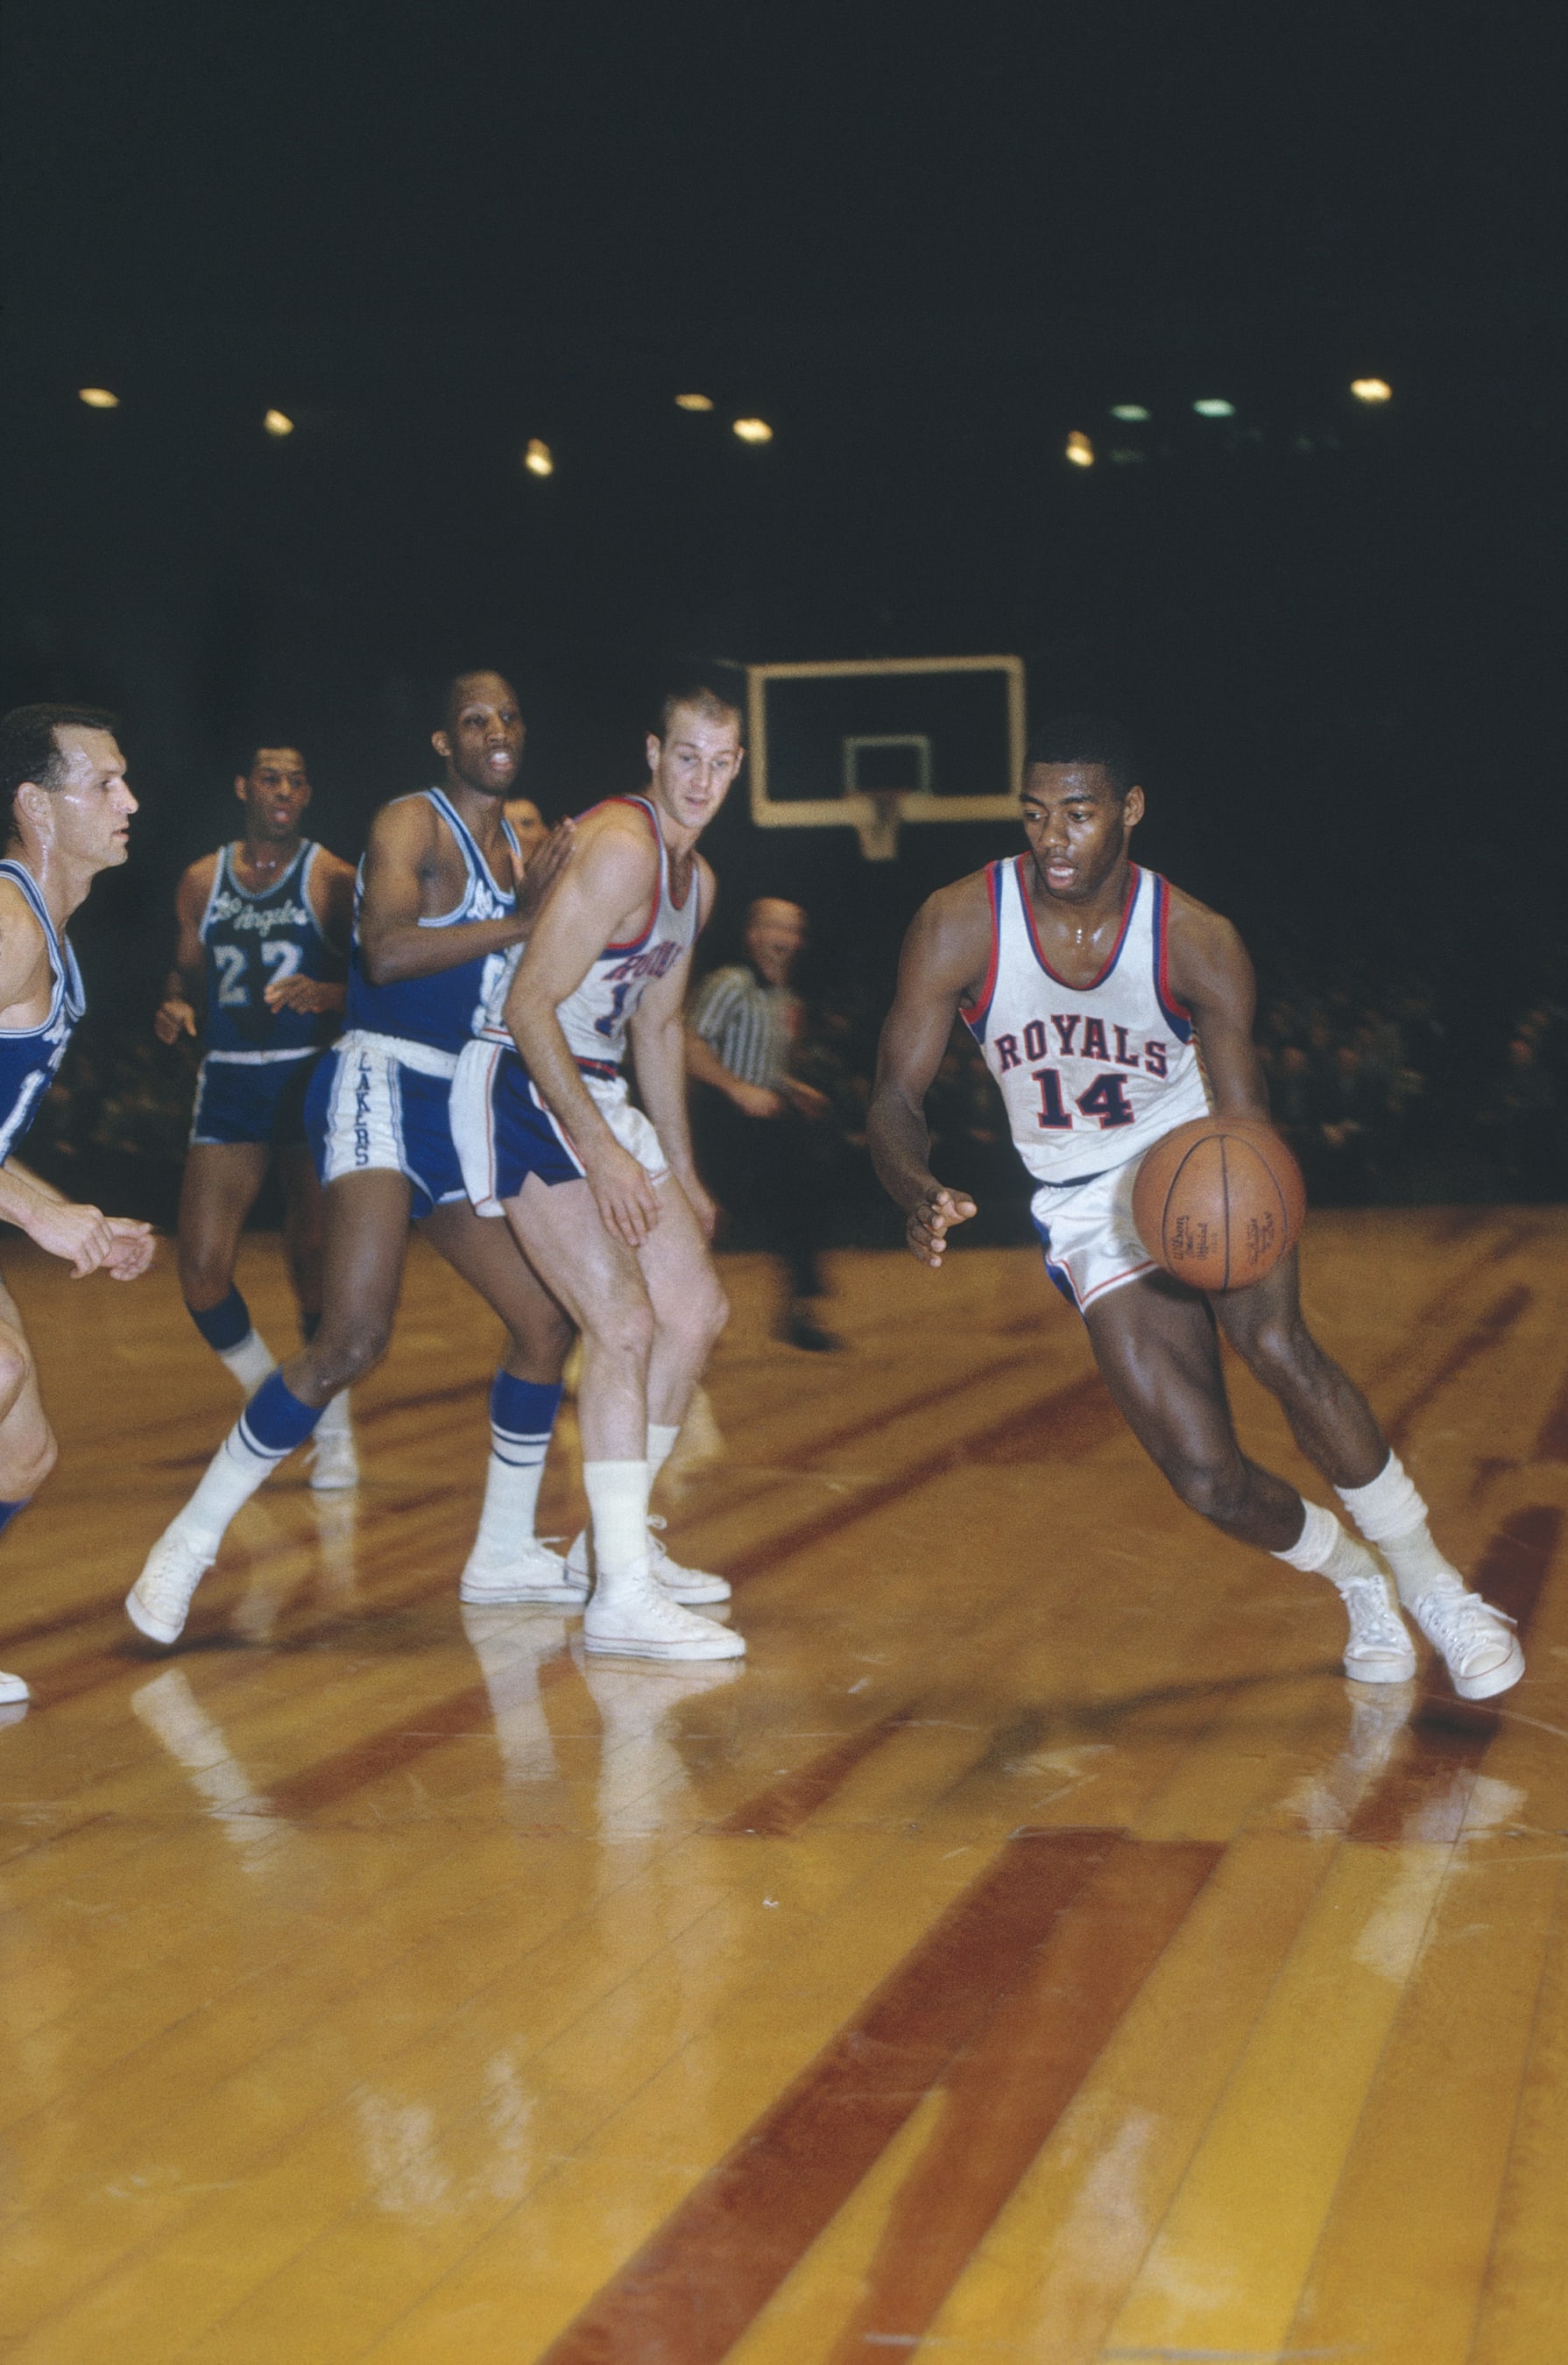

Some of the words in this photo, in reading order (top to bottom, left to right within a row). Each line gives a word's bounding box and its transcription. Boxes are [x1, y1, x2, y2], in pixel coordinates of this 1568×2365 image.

[213, 940, 302, 1006] 22
[994, 1014, 1169, 1078] ROYALS
[354, 1051, 372, 1166] LAKERS
[1032, 1068, 1135, 1130] 14
[1172, 1215, 1187, 1260] Wilson
